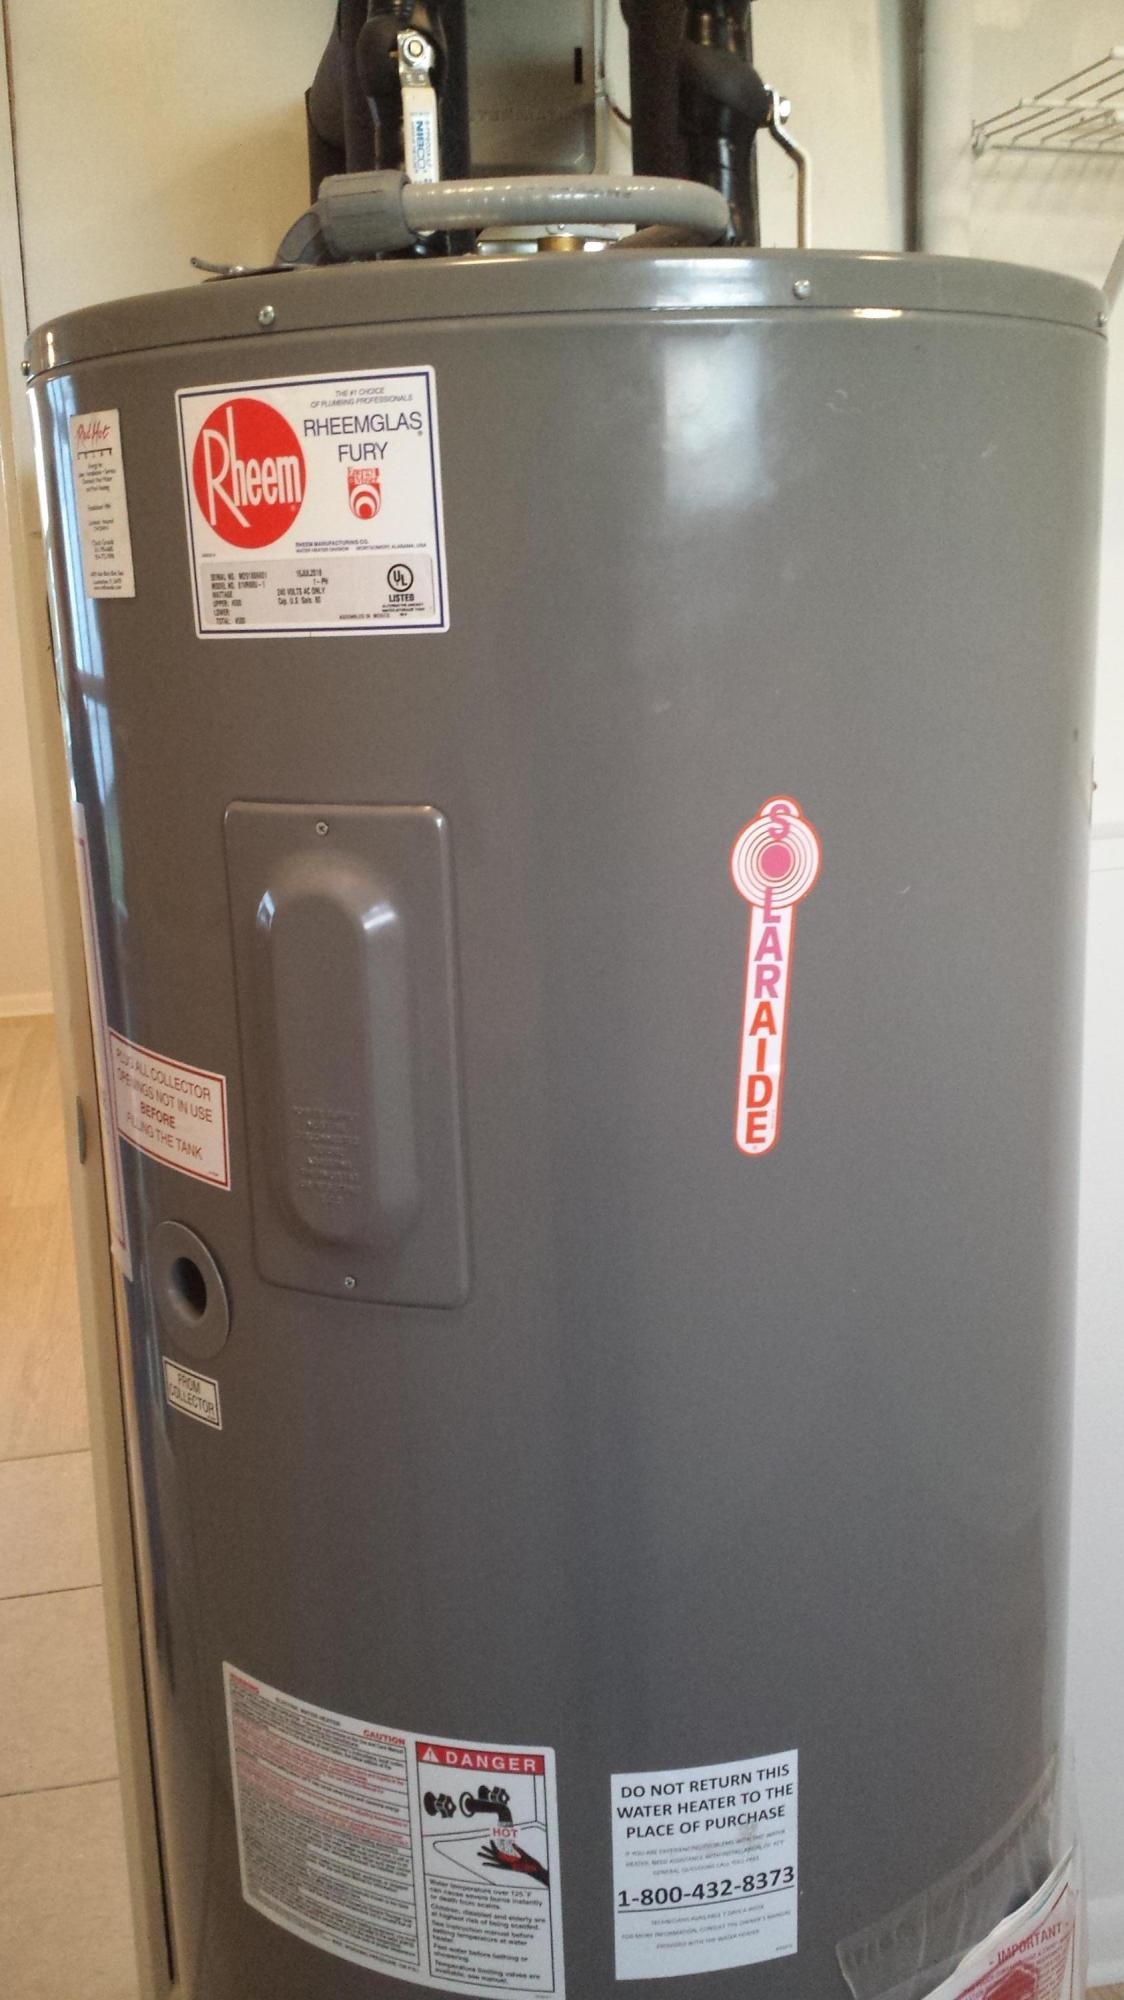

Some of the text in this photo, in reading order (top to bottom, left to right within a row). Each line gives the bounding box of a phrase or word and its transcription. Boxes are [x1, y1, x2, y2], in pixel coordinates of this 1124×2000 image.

[416, 121, 425, 169] NIBCO
[321, 398, 354, 407] PLUMBING
[355, 394, 413, 405] PROFESSIONALS
[359, 387, 384, 396] CHOICE
[304, 411, 423, 437] RHEEMGLAS
[338, 442, 388, 462] FURY
[203, 406, 302, 527] Rheem
[393, 570, 407, 586] UL
[389, 594, 414, 602] LISTED
[135, 1060, 149, 1078] ALL
[151, 1068, 210, 1101] COLLECTOR
[140, 1102, 176, 1128] BEFORE
[156, 1089, 176, 1109] NOT
[177, 1099, 188, 1114] IN
[190, 1105, 212, 1123] USE
[156, 1127, 173, 1148] THE
[363, 1729, 406, 1745] CAUTION
[446, 1751, 536, 1772] DANGER
[622, 1764, 790, 1798] DO NOT RETURN THIS
[617, 1783, 793, 1819] WATER HEATER TO THE
[493, 1828, 517, 1838] HOT
[627, 1805, 785, 1838] PLACE OF PURCHASE
[618, 1866, 794, 1907] 1-800-432-8373
[997, 1923, 1062, 1963] IMPORTANT
